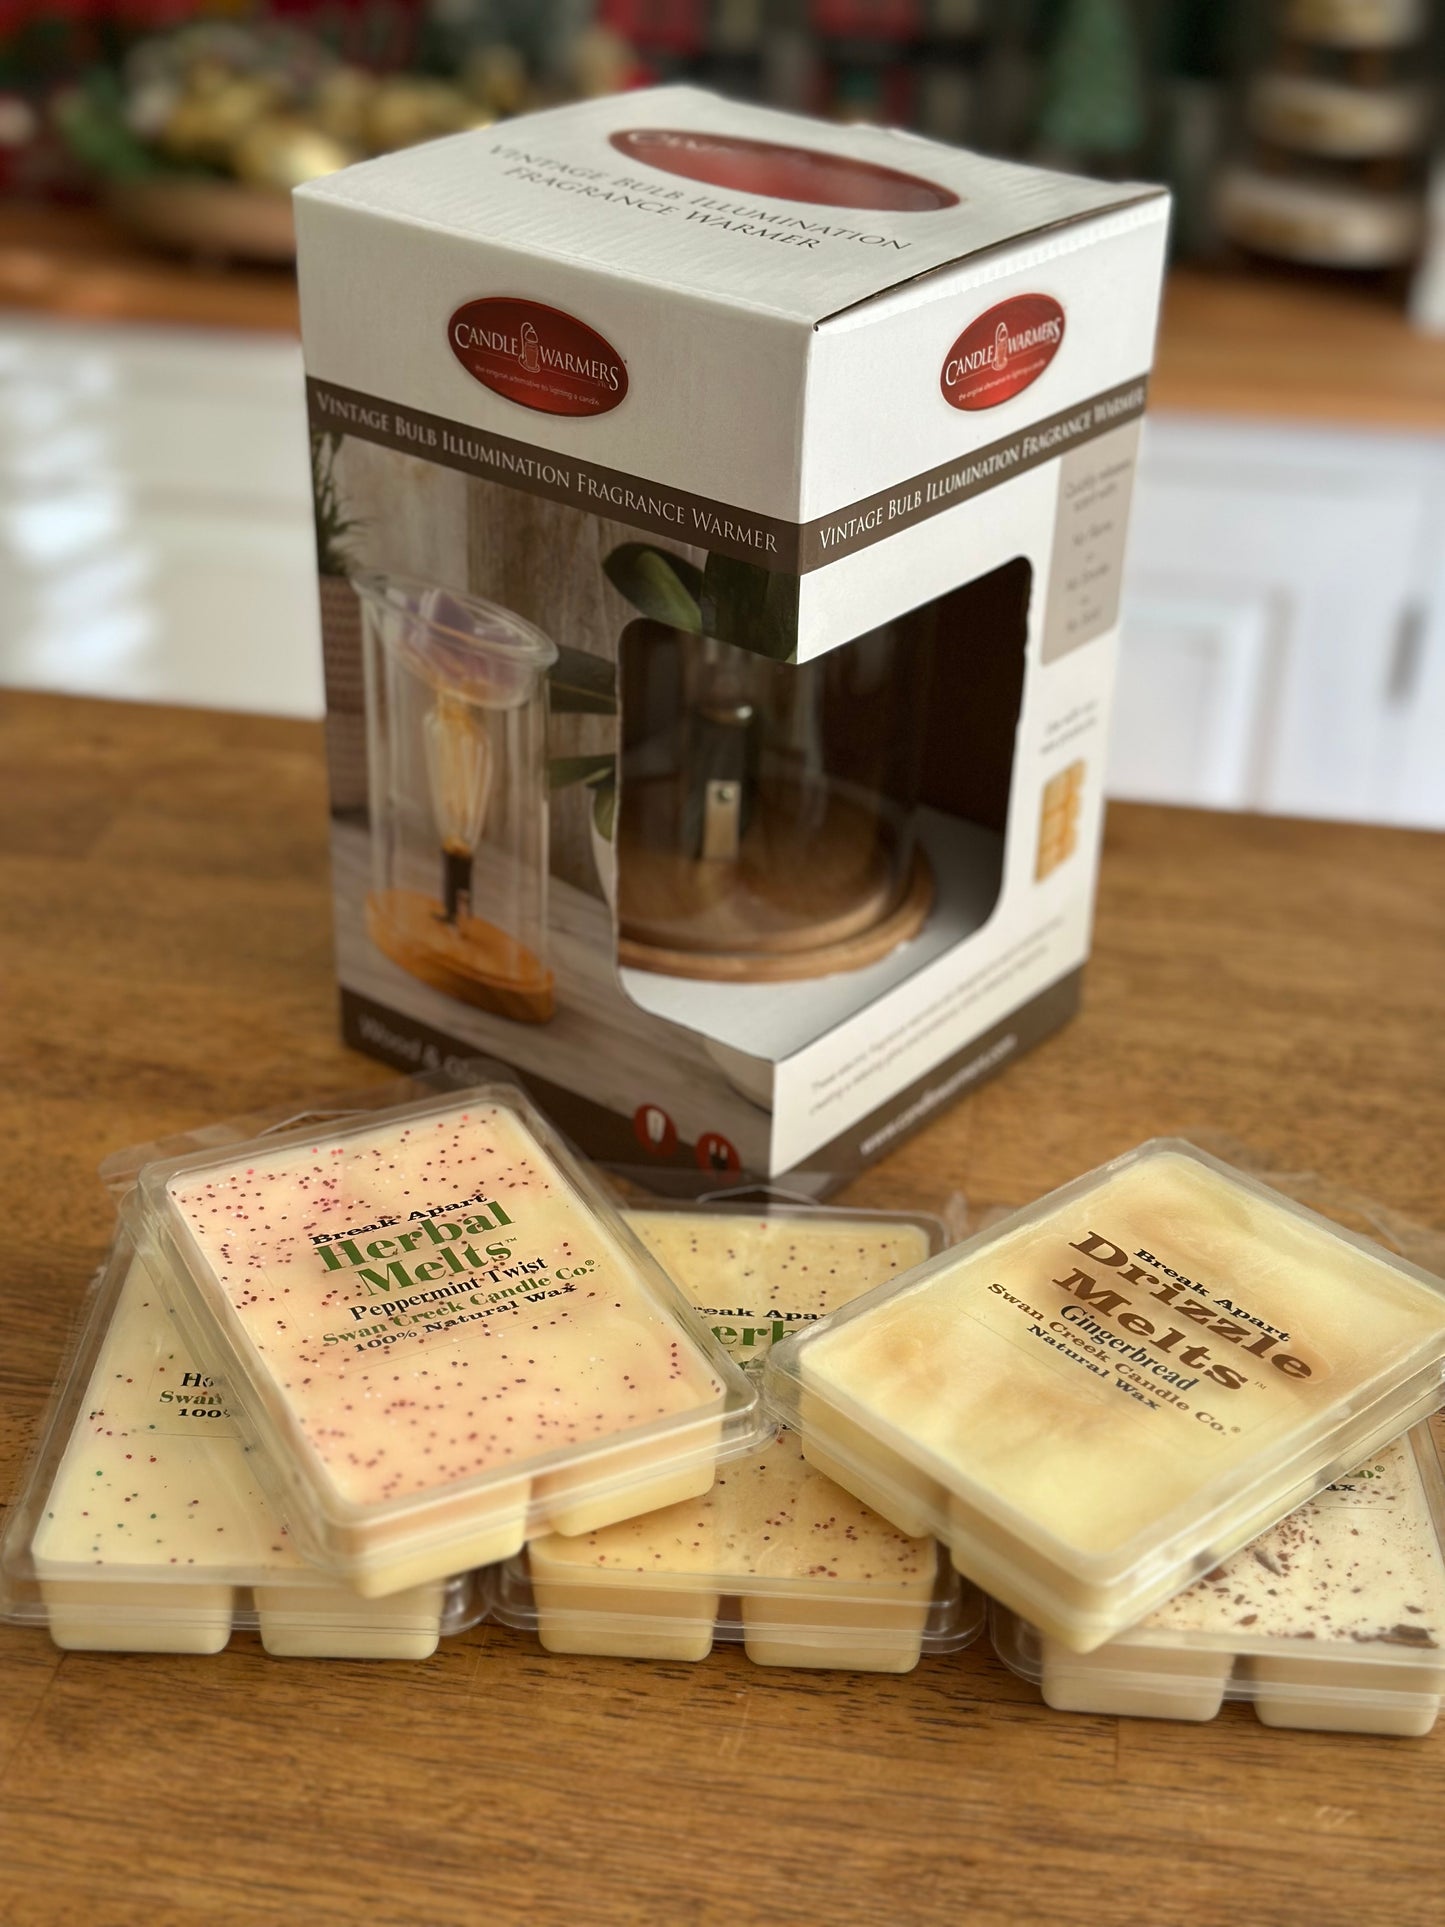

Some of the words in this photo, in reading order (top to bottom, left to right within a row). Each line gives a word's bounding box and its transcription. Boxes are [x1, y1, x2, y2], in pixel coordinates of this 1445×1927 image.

[490, 144, 607, 184] VINTAGE
[611, 175, 685, 201] BULB
[689, 193, 912, 251] ILLUMINATION
[504, 165, 682, 216] FRAGRANCE
[686, 210, 823, 250] WARMER
[455, 323, 519, 357] CANDLE
[540, 345, 620, 392] WARMERS
[946, 345, 995, 386] CANDLE
[1008, 317, 1062, 354] WARMERS
[315, 390, 390, 433] VINTAGE
[395, 415, 438, 447] BULB
[442, 425, 570, 488] ILLUMINATION
[577, 472, 686, 525] FRAGRANCE
[692, 507, 779, 553] WARMER
[820, 507, 884, 550] VINTAGE
[888, 490, 922, 521] BULB
[926, 446, 1021, 504] ILLUMINATION
[1022, 413, 1092, 460] FRAGRANCE
[310, 1216, 400, 1246] Break
[407, 1194, 488, 1222] Apart
[313, 1200, 516, 1273] Herbal
[322, 1322, 388, 1347] Swan
[393, 1302, 466, 1329] Creek
[469, 1275, 552, 1307] Candle
[348, 1276, 482, 1322] Peppermint
[483, 1256, 548, 1285] Twist
[353, 1329, 418, 1352] 100%
[423, 1300, 520, 1334] Natural
[524, 1284, 578, 1304] Wax
[1068, 1230, 1313, 1380] Drizzle
[1133, 1248, 1210, 1298] Break
[1213, 1296, 1291, 1343] Apart
[987, 1282, 1045, 1322] Swan
[1049, 1321, 1111, 1364] Creek
[1114, 1361, 1190, 1412] Candle
[1027, 1323, 1111, 1379] Natural
[1114, 1379, 1162, 1411] Wax
[1060, 1304, 1200, 1393] Gingerbread
